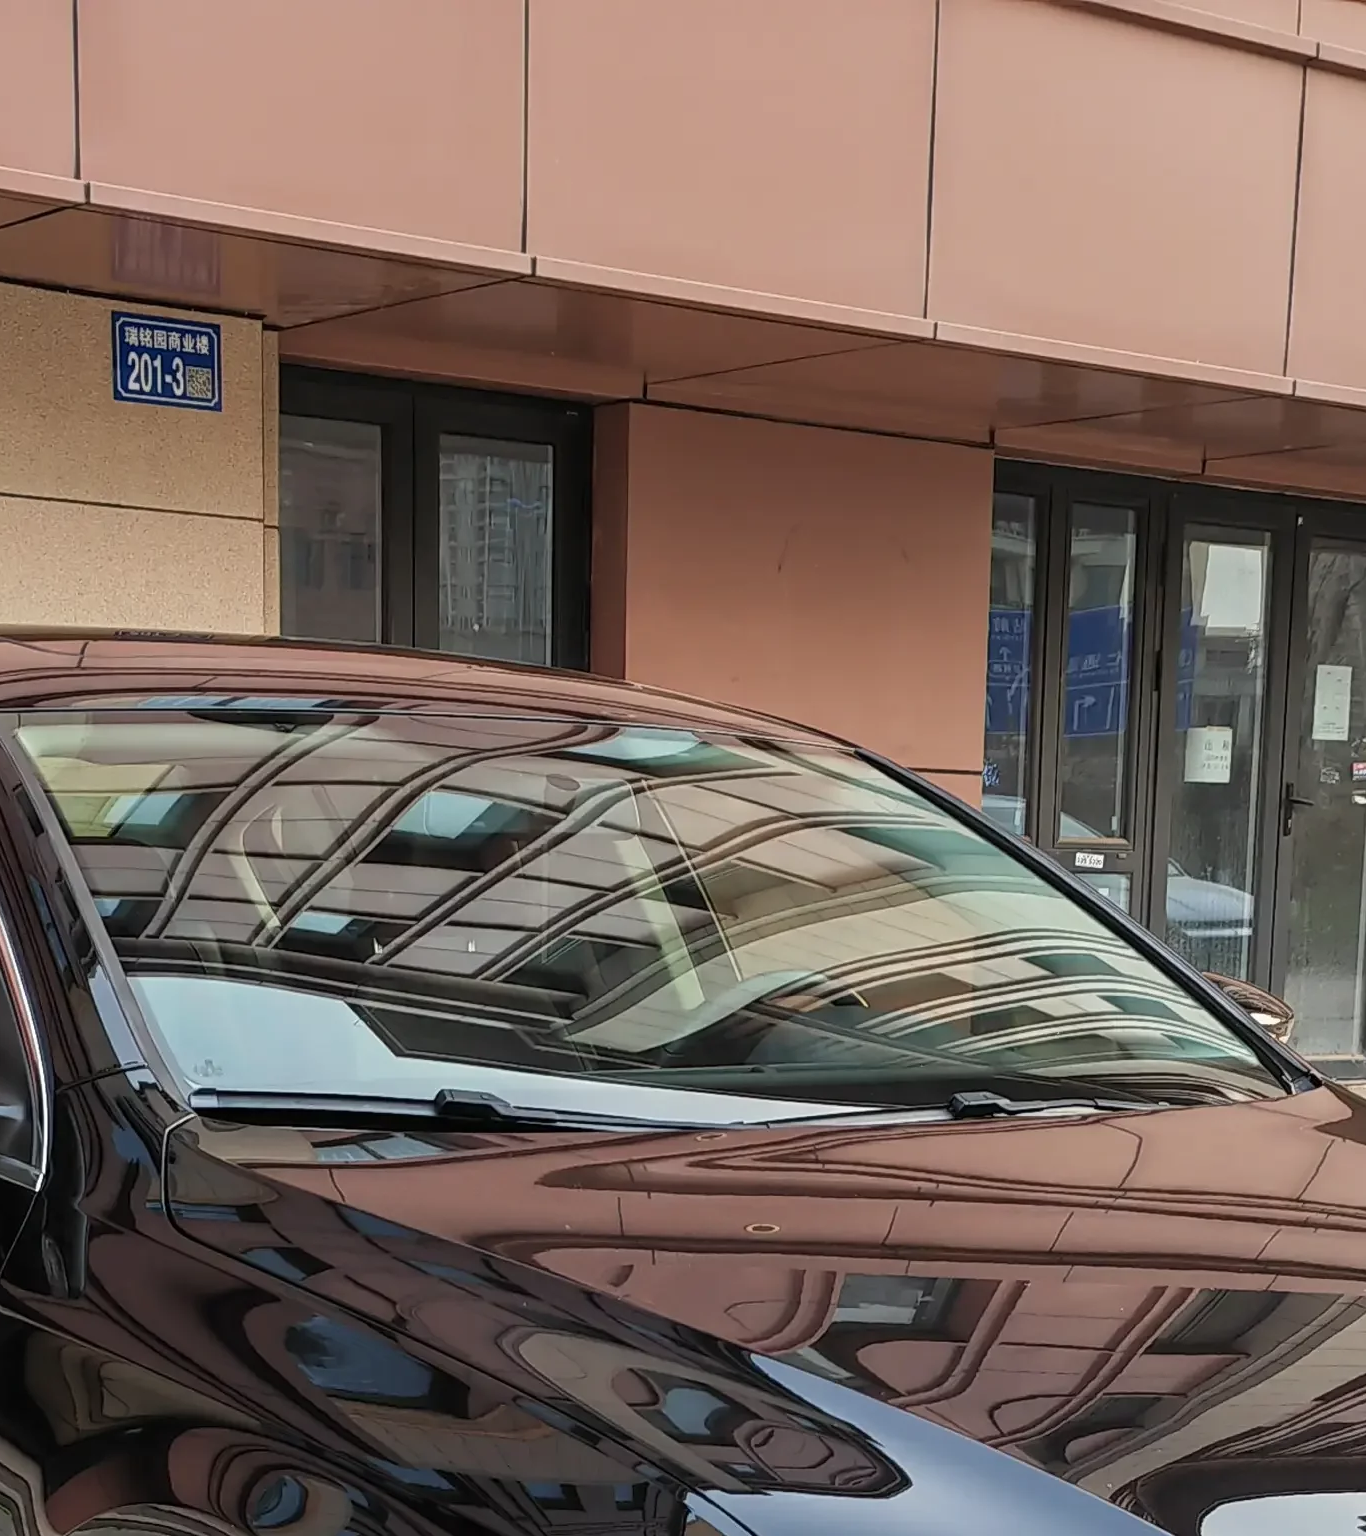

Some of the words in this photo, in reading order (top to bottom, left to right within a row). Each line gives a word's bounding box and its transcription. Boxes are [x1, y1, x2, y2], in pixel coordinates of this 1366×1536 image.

[124, 326, 210, 355] 瑞铭园商业楼
[127, 351, 184, 396] 201-3
